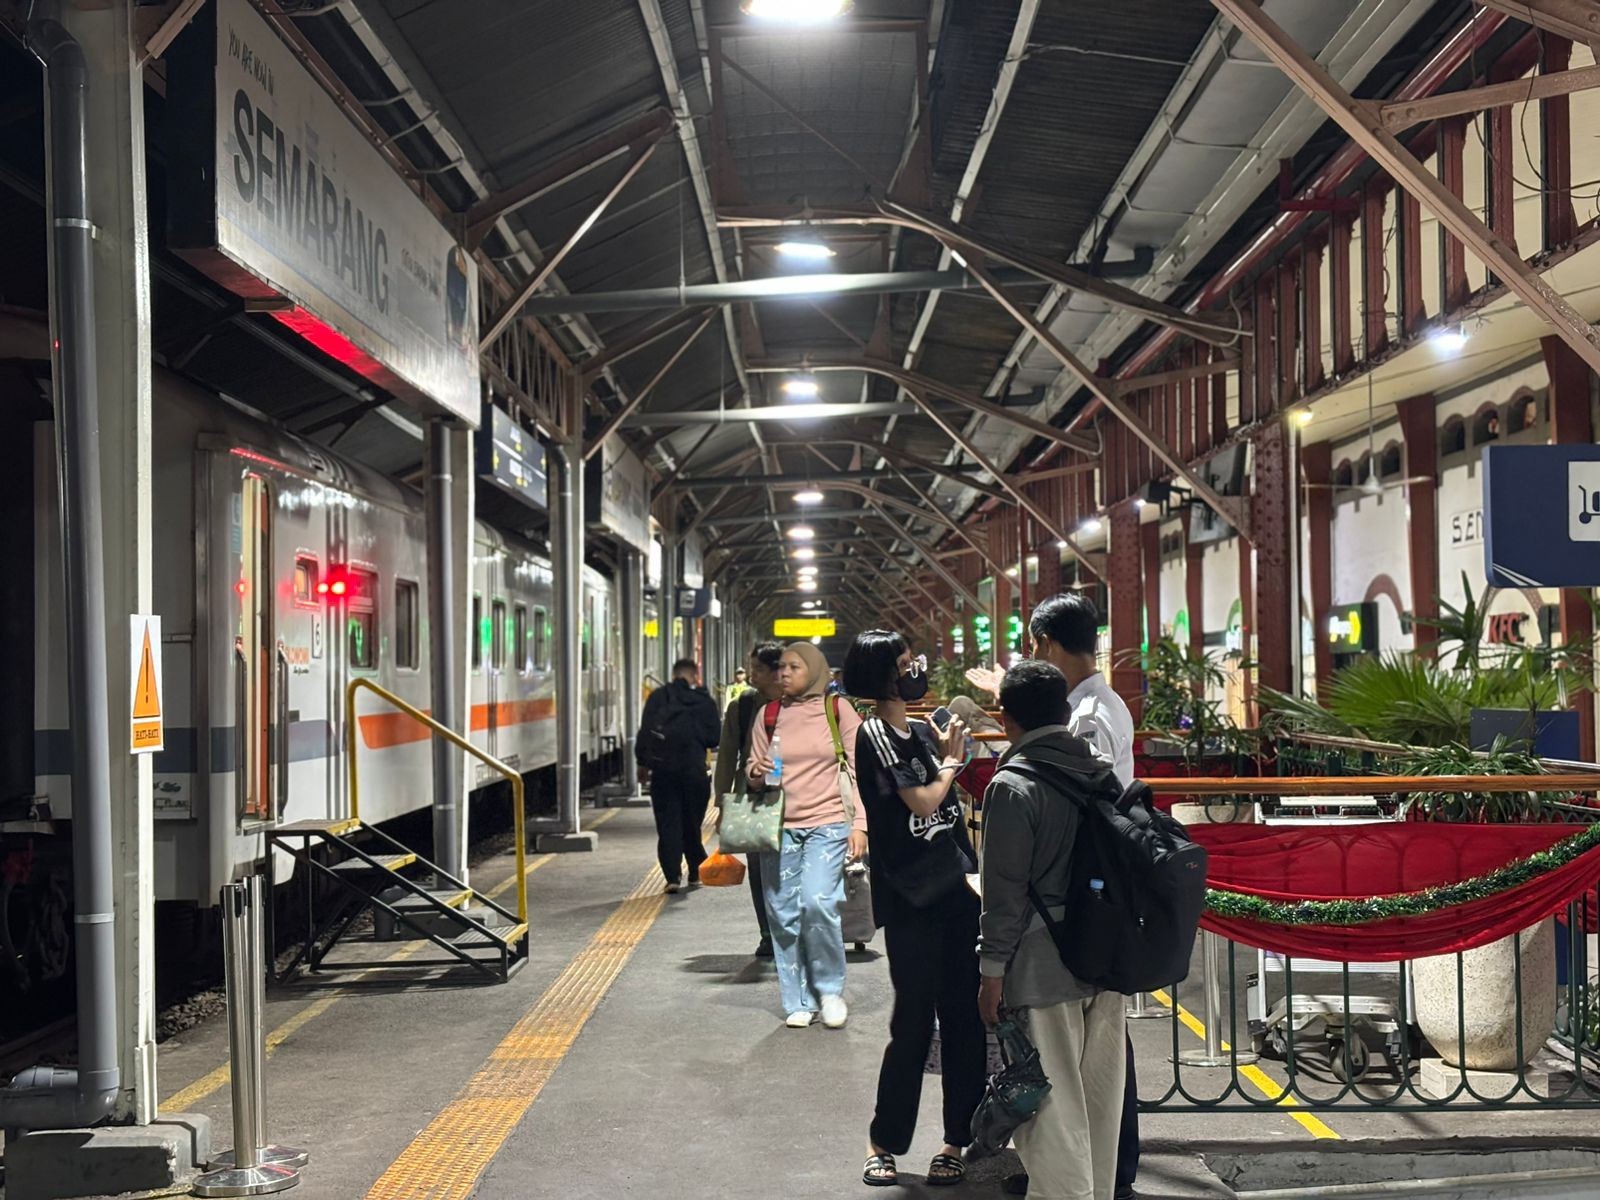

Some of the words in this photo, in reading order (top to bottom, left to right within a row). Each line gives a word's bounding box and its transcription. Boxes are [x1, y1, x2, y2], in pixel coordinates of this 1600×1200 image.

[233, 88, 389, 316] SEMARANG
[316, 621, 321, 646] 6
[1488, 612, 1527, 644] KFC
[135, 727, 160, 741] HATI-HATI
